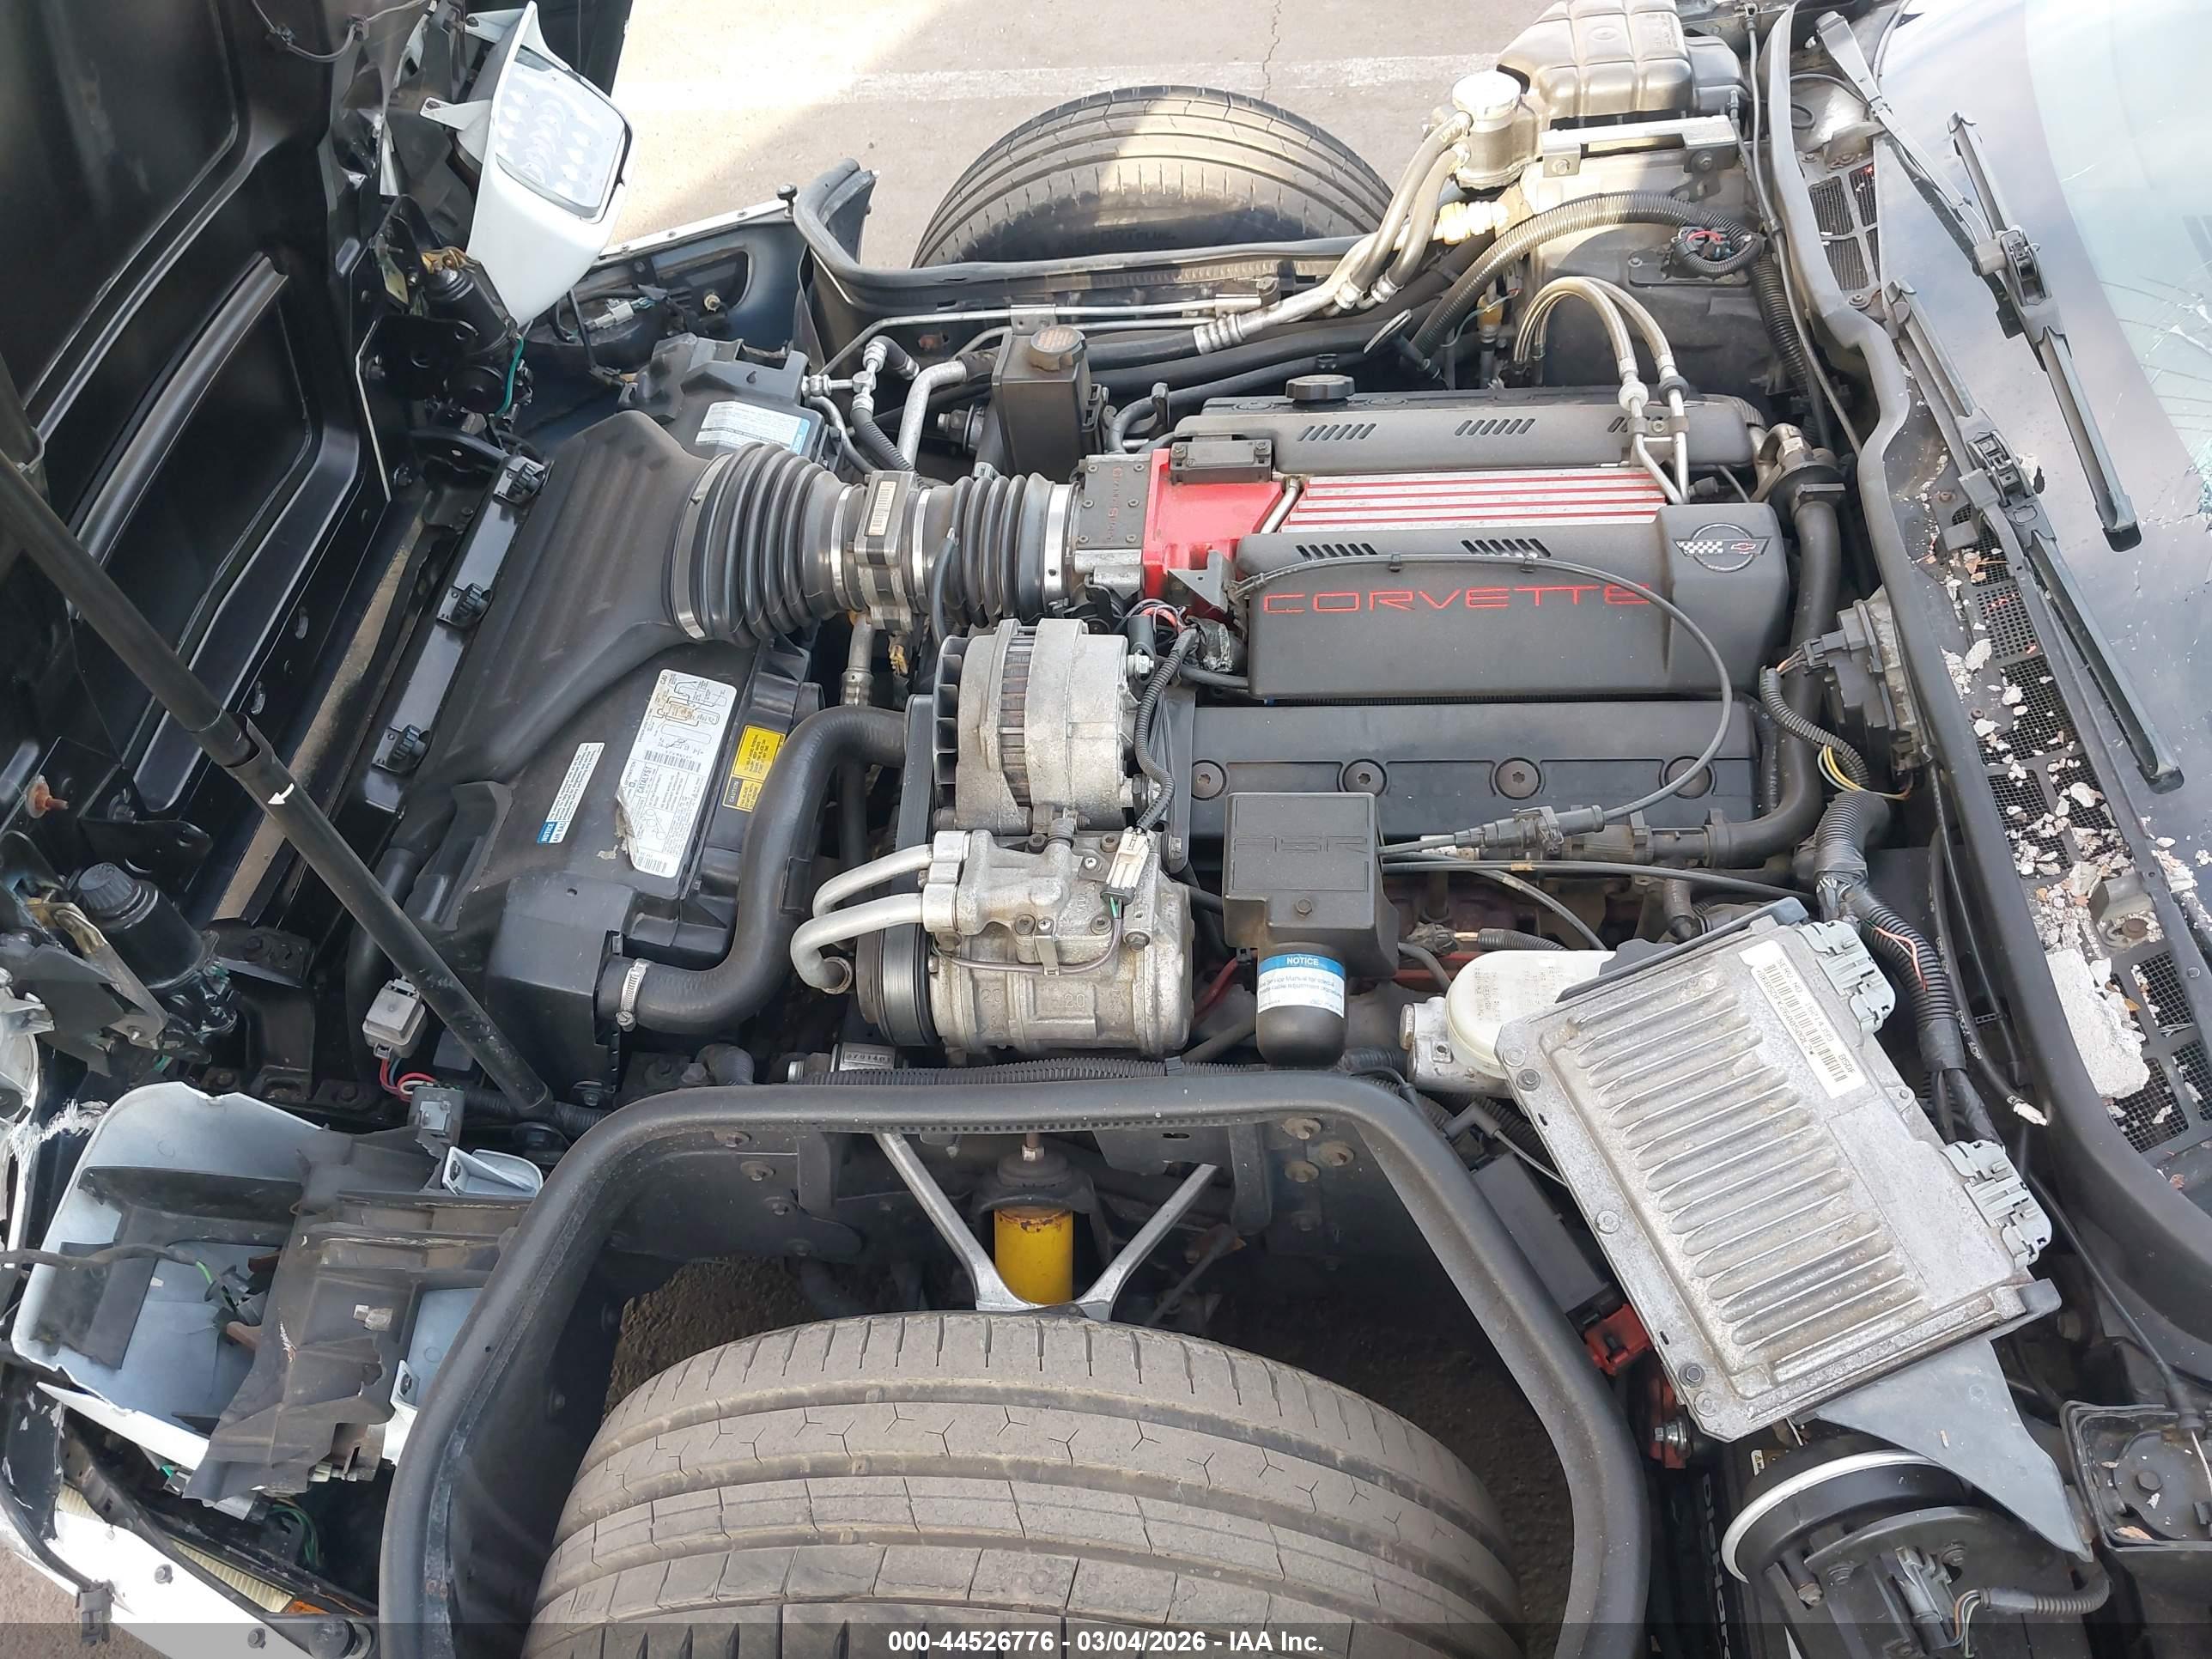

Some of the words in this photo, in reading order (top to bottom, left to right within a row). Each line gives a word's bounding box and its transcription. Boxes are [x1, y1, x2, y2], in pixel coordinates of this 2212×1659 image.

[1263, 583, 1651, 614] CORVETTE
[729, 781, 739, 803] CAUTION
[541, 823, 555, 842] NOTICE
[1286, 957, 1320, 966] NOTICE
[1064, 994, 1086, 1009] 20
